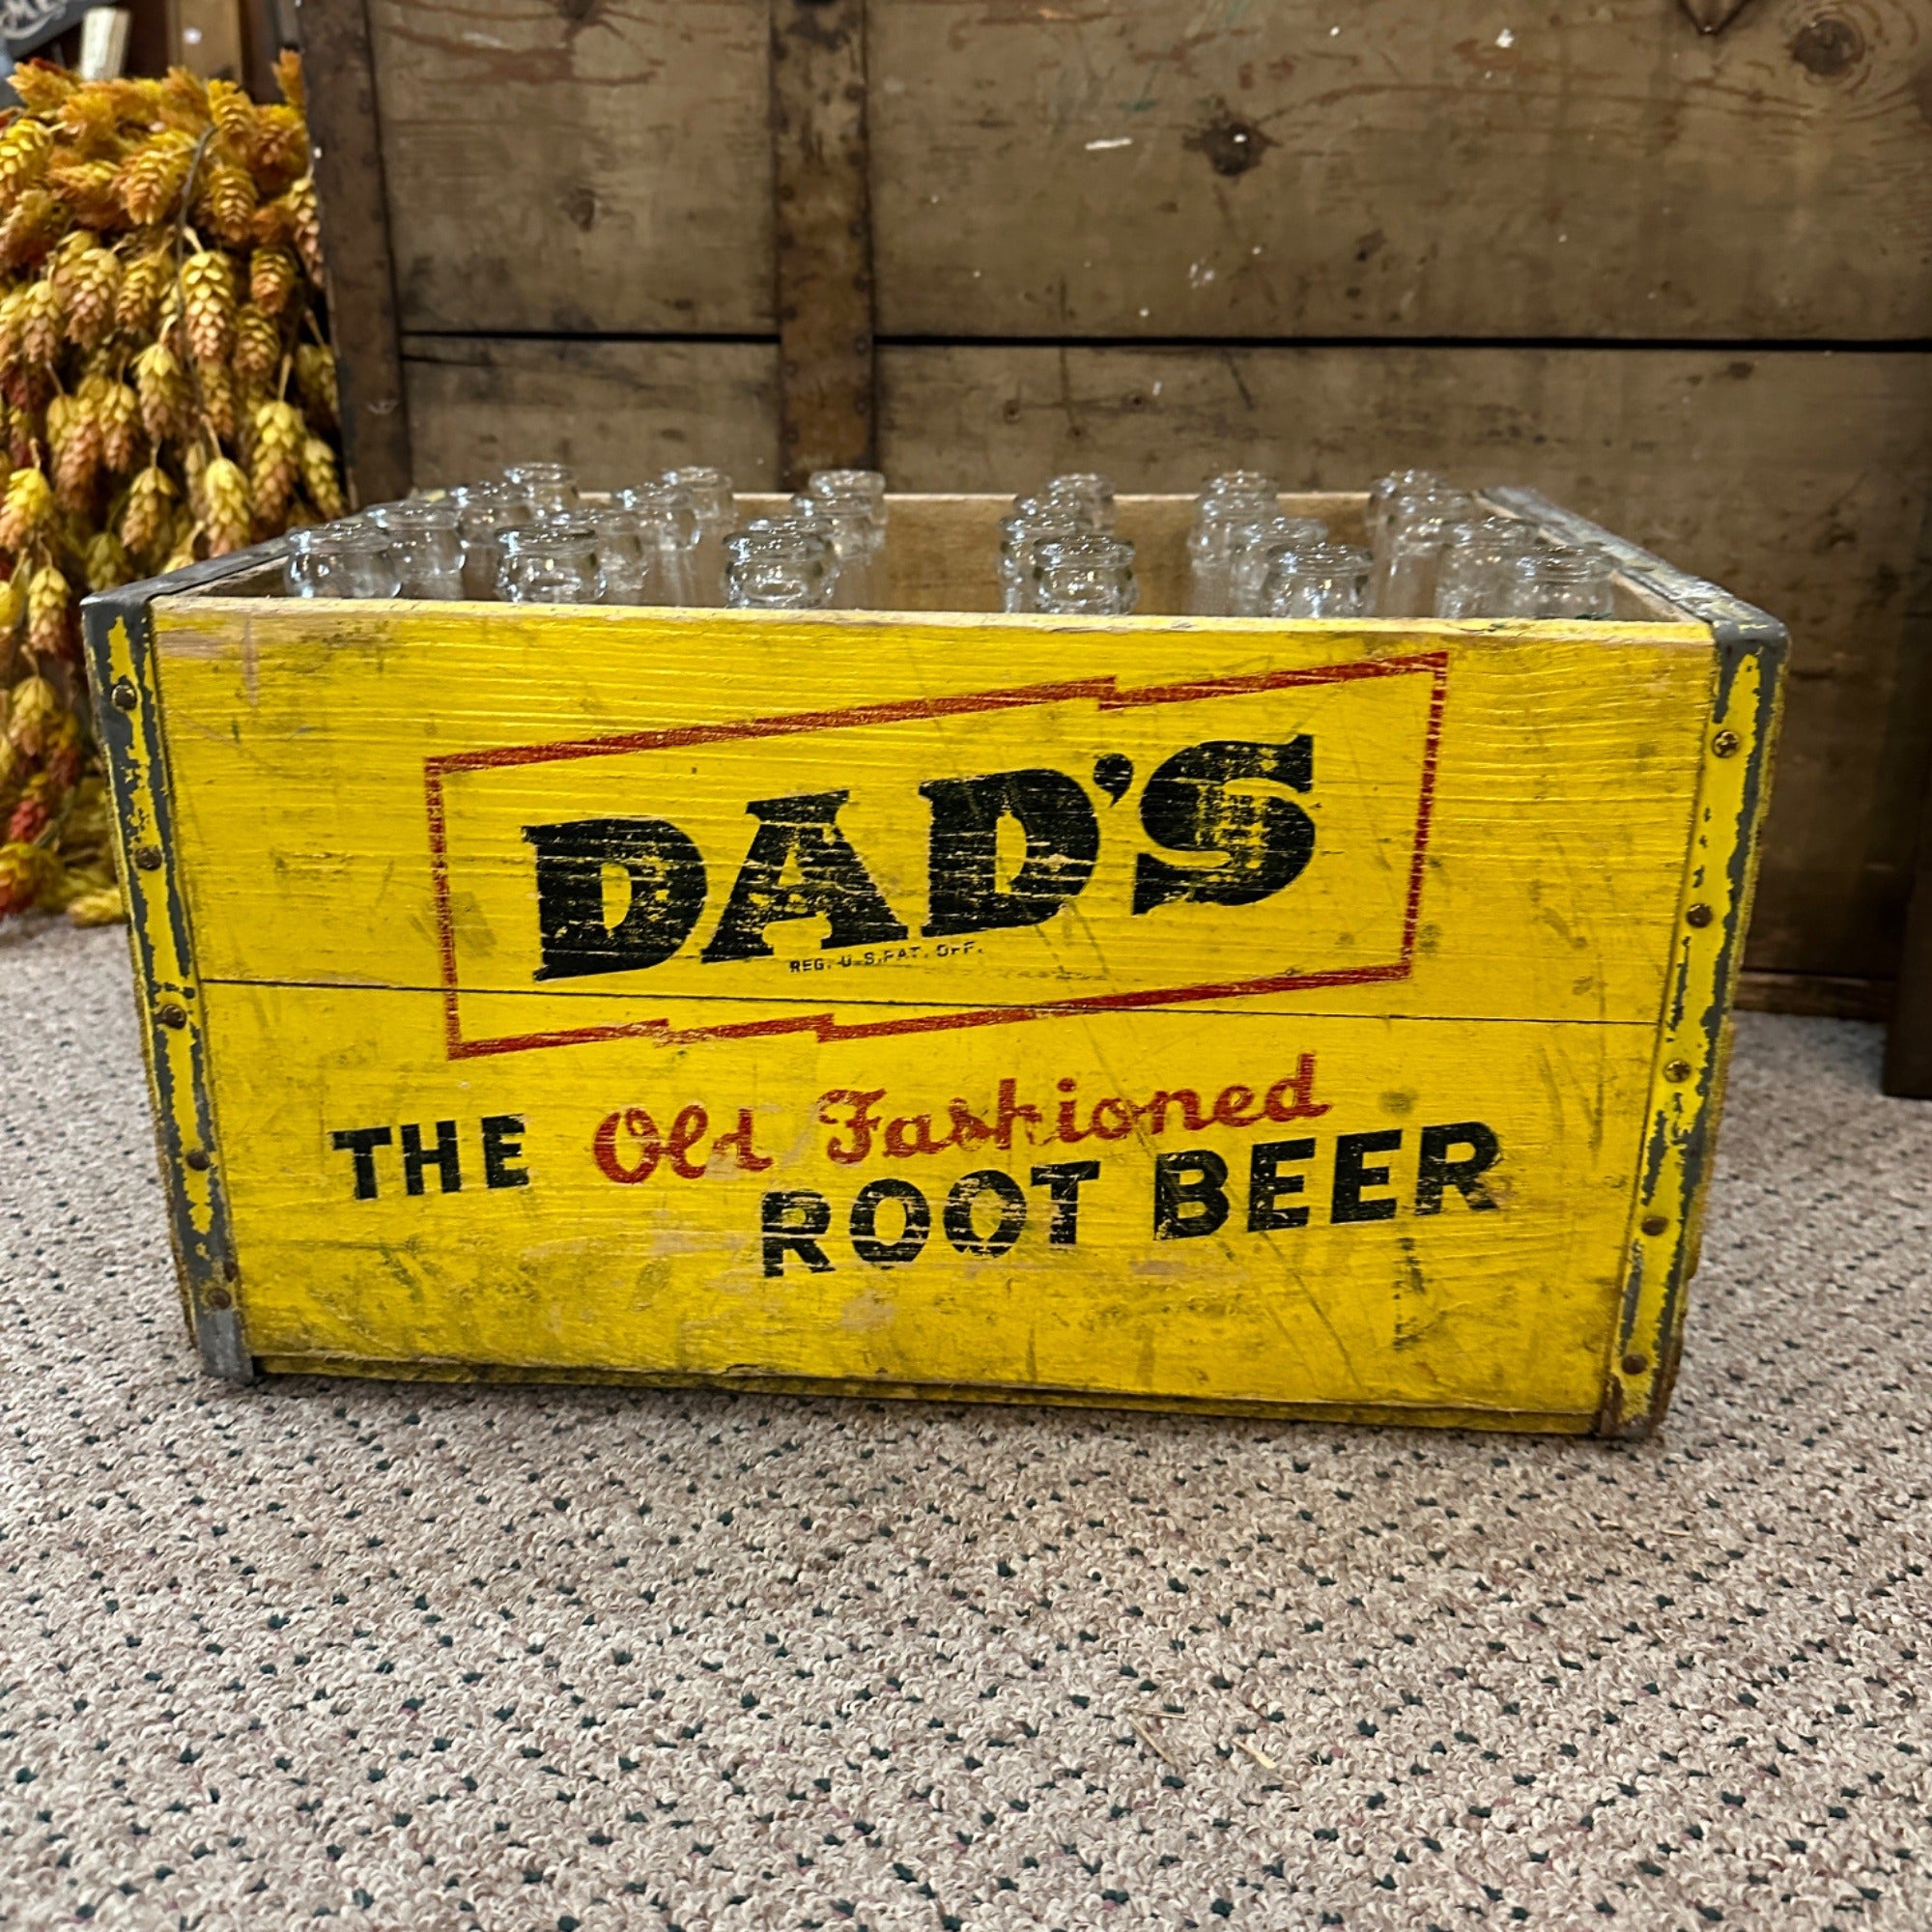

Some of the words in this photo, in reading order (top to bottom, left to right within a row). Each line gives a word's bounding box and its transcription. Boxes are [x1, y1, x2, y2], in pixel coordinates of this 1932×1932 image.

[522, 734, 1316, 981] DAD'S
[330, 1112, 530, 1201] THE
[592, 1104, 773, 1184] Old
[817, 1049, 1333, 1164] Fashioned
[761, 1160, 1101, 1278] ROOT
[1152, 1120, 1505, 1242] BEER
